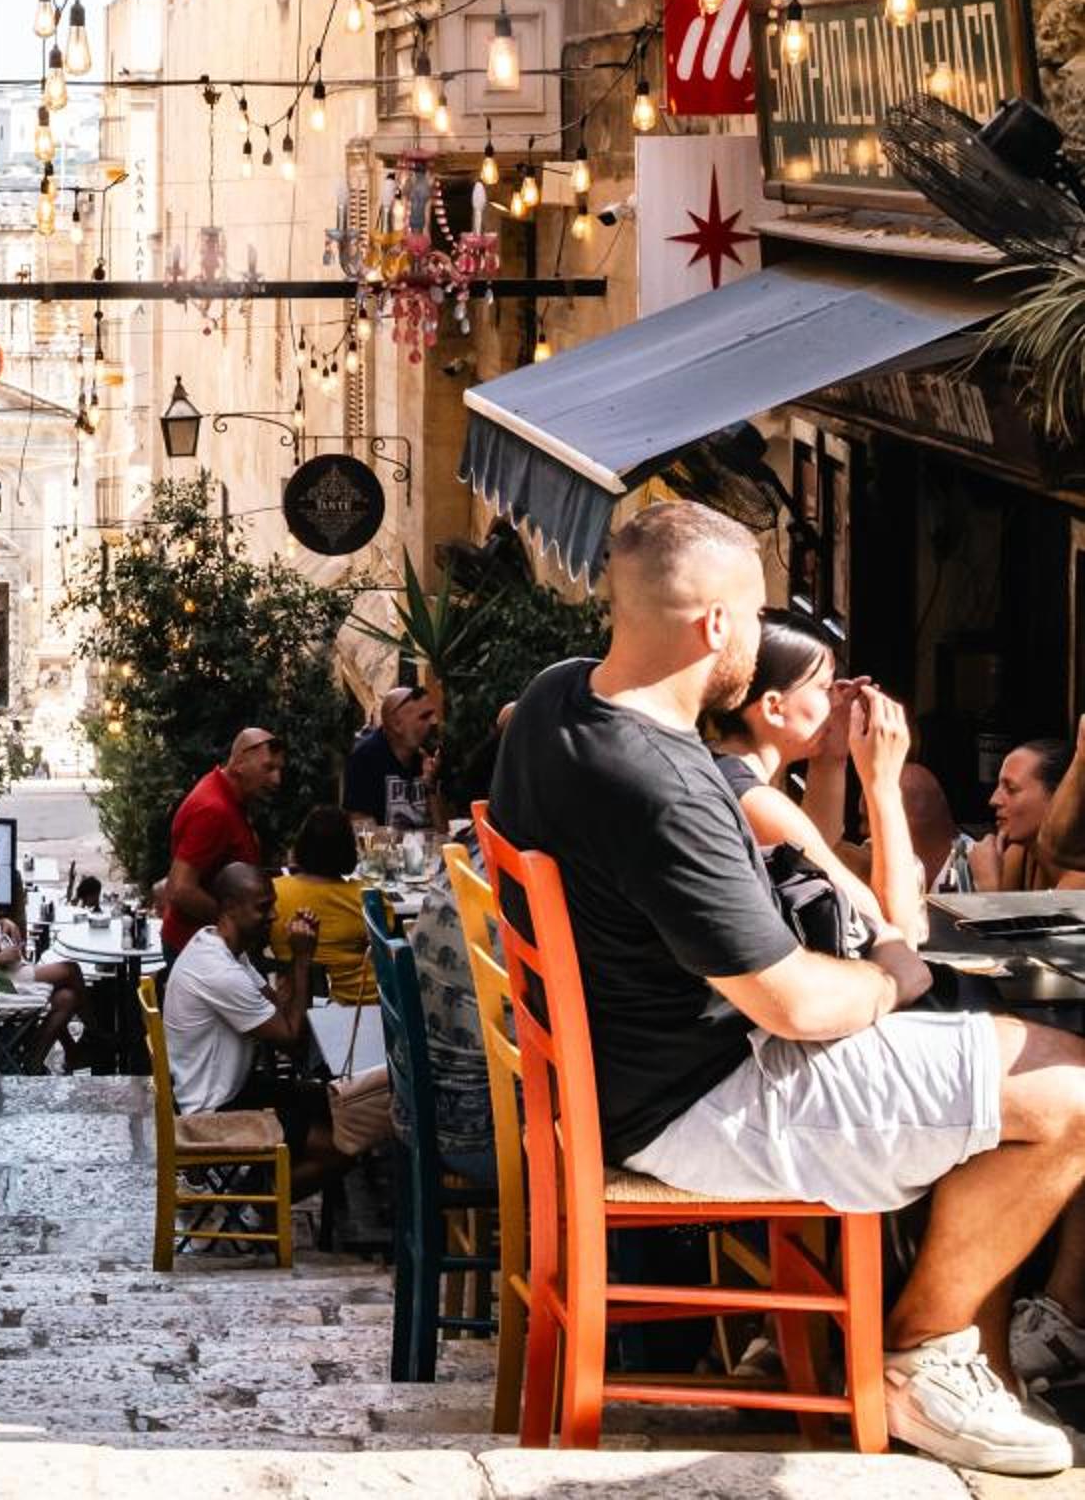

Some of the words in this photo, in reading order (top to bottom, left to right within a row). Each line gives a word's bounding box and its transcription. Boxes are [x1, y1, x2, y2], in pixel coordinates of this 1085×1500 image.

[806, 18, 876, 125] PAOLO
[134, 158, 146, 214] CASA
[134, 230, 146, 316] LAPIA
